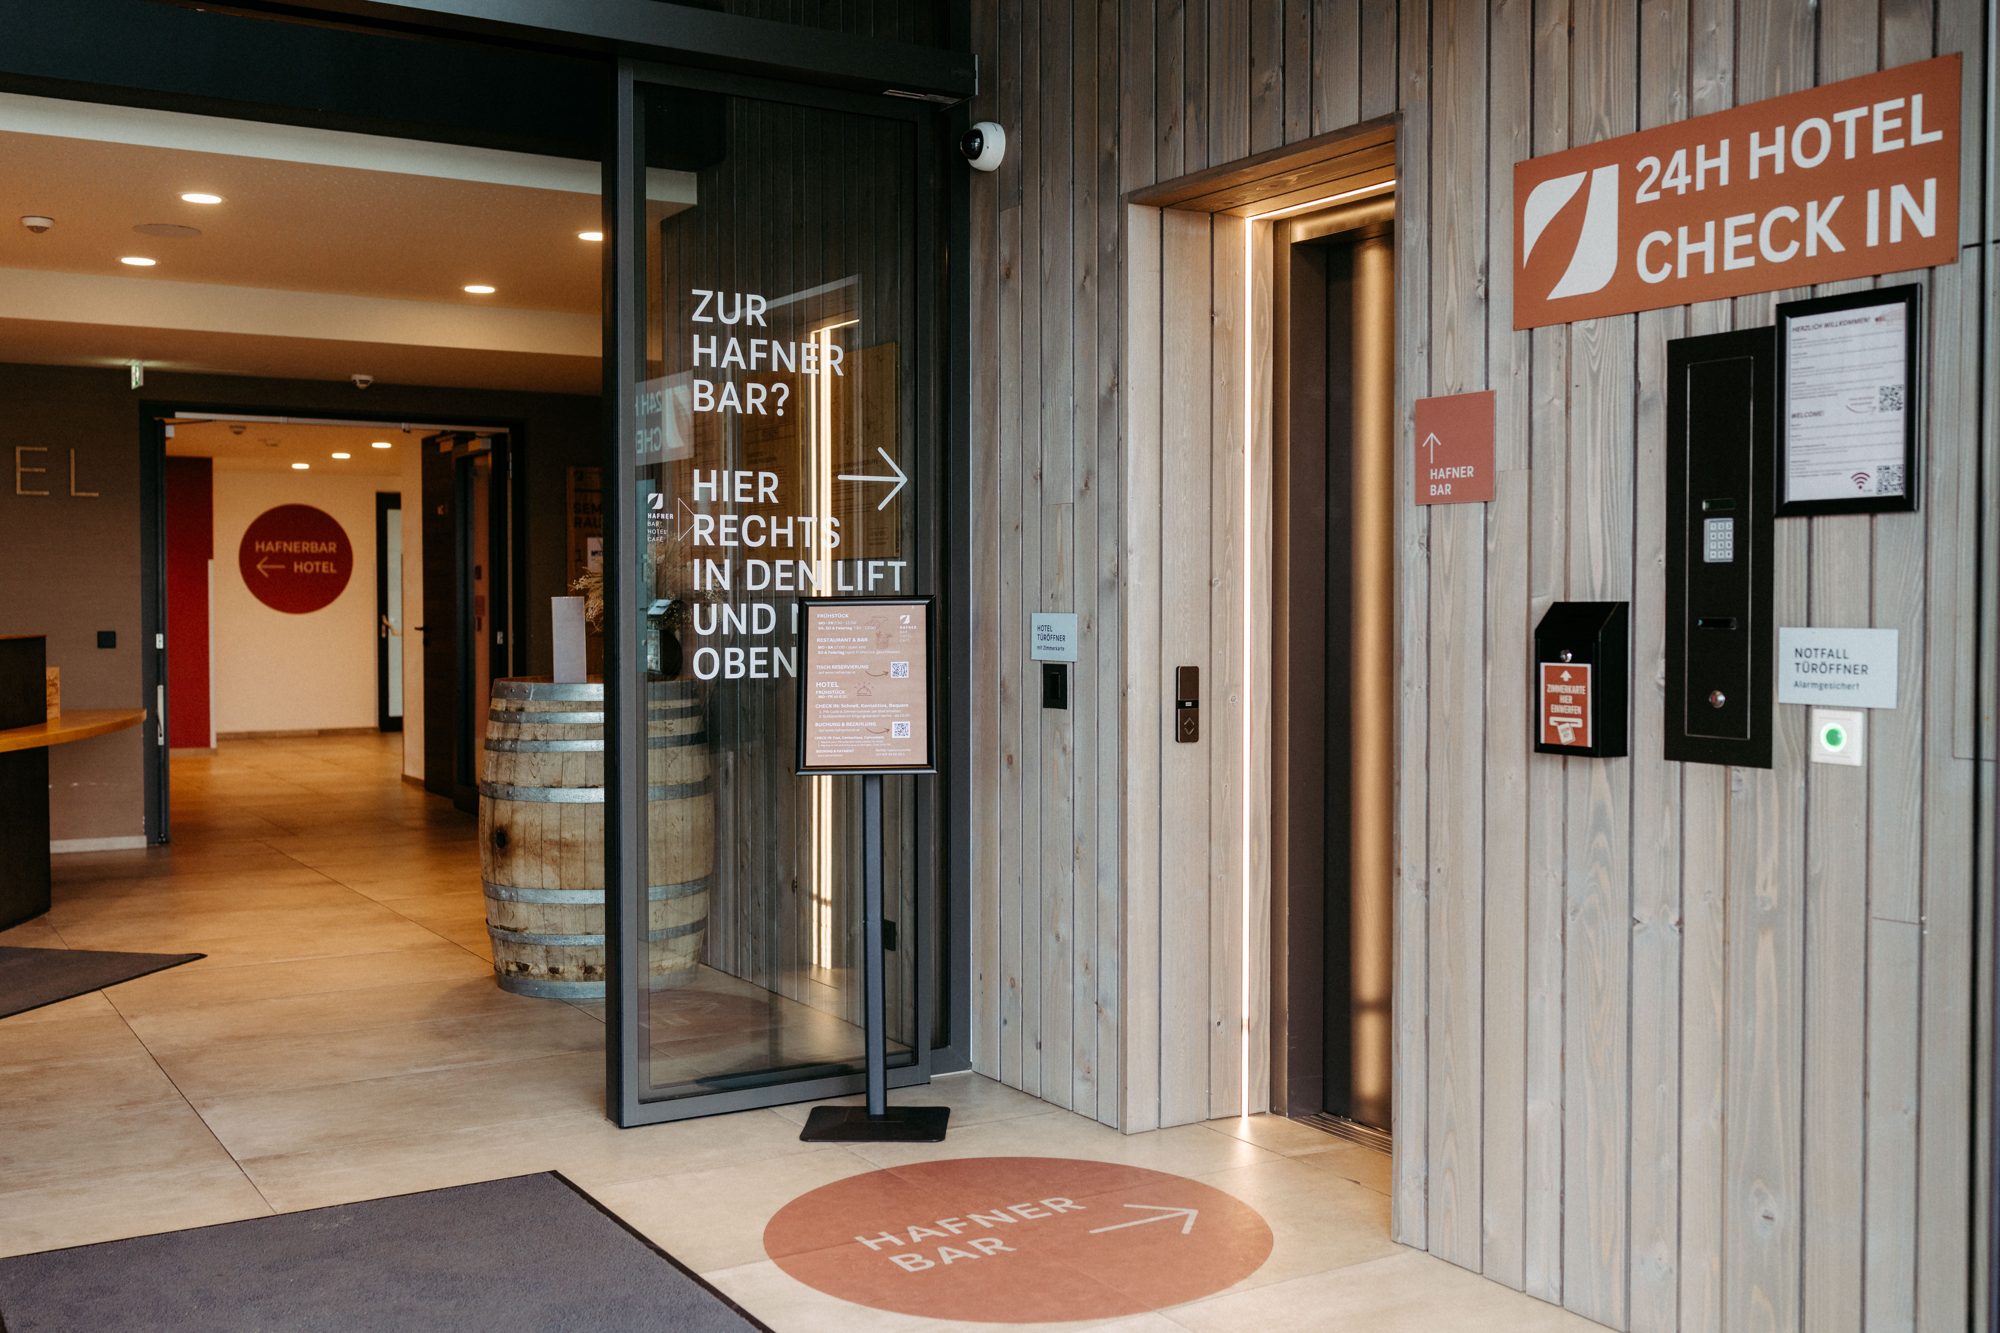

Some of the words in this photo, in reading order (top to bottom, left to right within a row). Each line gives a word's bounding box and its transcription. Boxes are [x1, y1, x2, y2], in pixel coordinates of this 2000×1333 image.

[1634, 138, 1730, 205] 24H
[1749, 93, 1944, 180] HOTEL
[1635, 195, 1847, 284] CHECK
[1866, 177, 1937, 248] IN
[691, 288, 768, 327] ZUR
[693, 334, 844, 377] HAFNER
[693, 379, 790, 417] BAR?
[693, 469, 780, 504] HIER
[1430, 465, 1475, 480] HAFNER
[1430, 483, 1452, 496] BAR
[255, 541, 337, 554] HAFNERBAR
[693, 514, 841, 549] RECHTS
[293, 561, 337, 574] HOTEL
[693, 559, 731, 591] IN
[746, 559, 822, 592] DEN
[837, 560, 907, 592] LIFT
[693, 602, 776, 636] UND
[1037, 633, 1066, 642] TÜRÖFFNER
[1794, 647, 1849, 661] NOTFALL
[692, 647, 797, 681] OBEN
[1794, 660, 1869, 676] TÜRÖFFNER
[1793, 680, 1860, 692] Alarmgesichert
[854, 1195, 1087, 1252] HAFNER
[888, 1237, 1018, 1273] BAR
